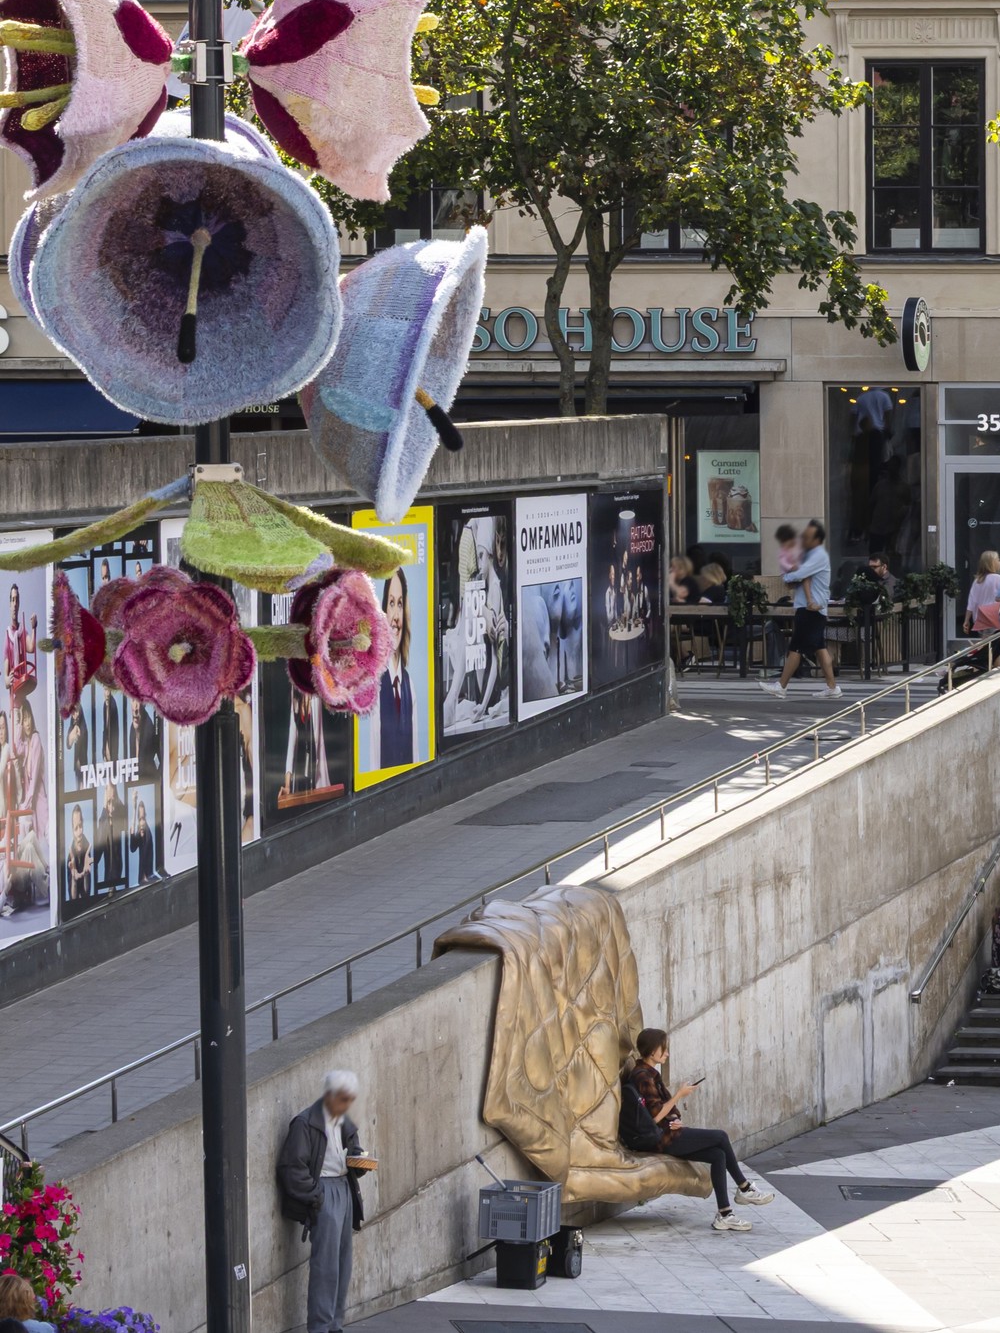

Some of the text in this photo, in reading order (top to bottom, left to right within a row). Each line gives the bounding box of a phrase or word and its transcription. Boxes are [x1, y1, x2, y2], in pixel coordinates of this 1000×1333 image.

[557, 307, 757, 353] HOUSE
[245, 404, 280, 413] HOUSE
[711, 459, 748, 467] Caramel
[520, 521, 583, 552] OMFAMNAD
[630, 524, 655, 539] RAT PACK
[630, 539, 655, 553] RHAPSODY
[464, 590, 486, 619] POP
[465, 617, 486, 646] UP
[80, 757, 139, 789] TARTUFFE
